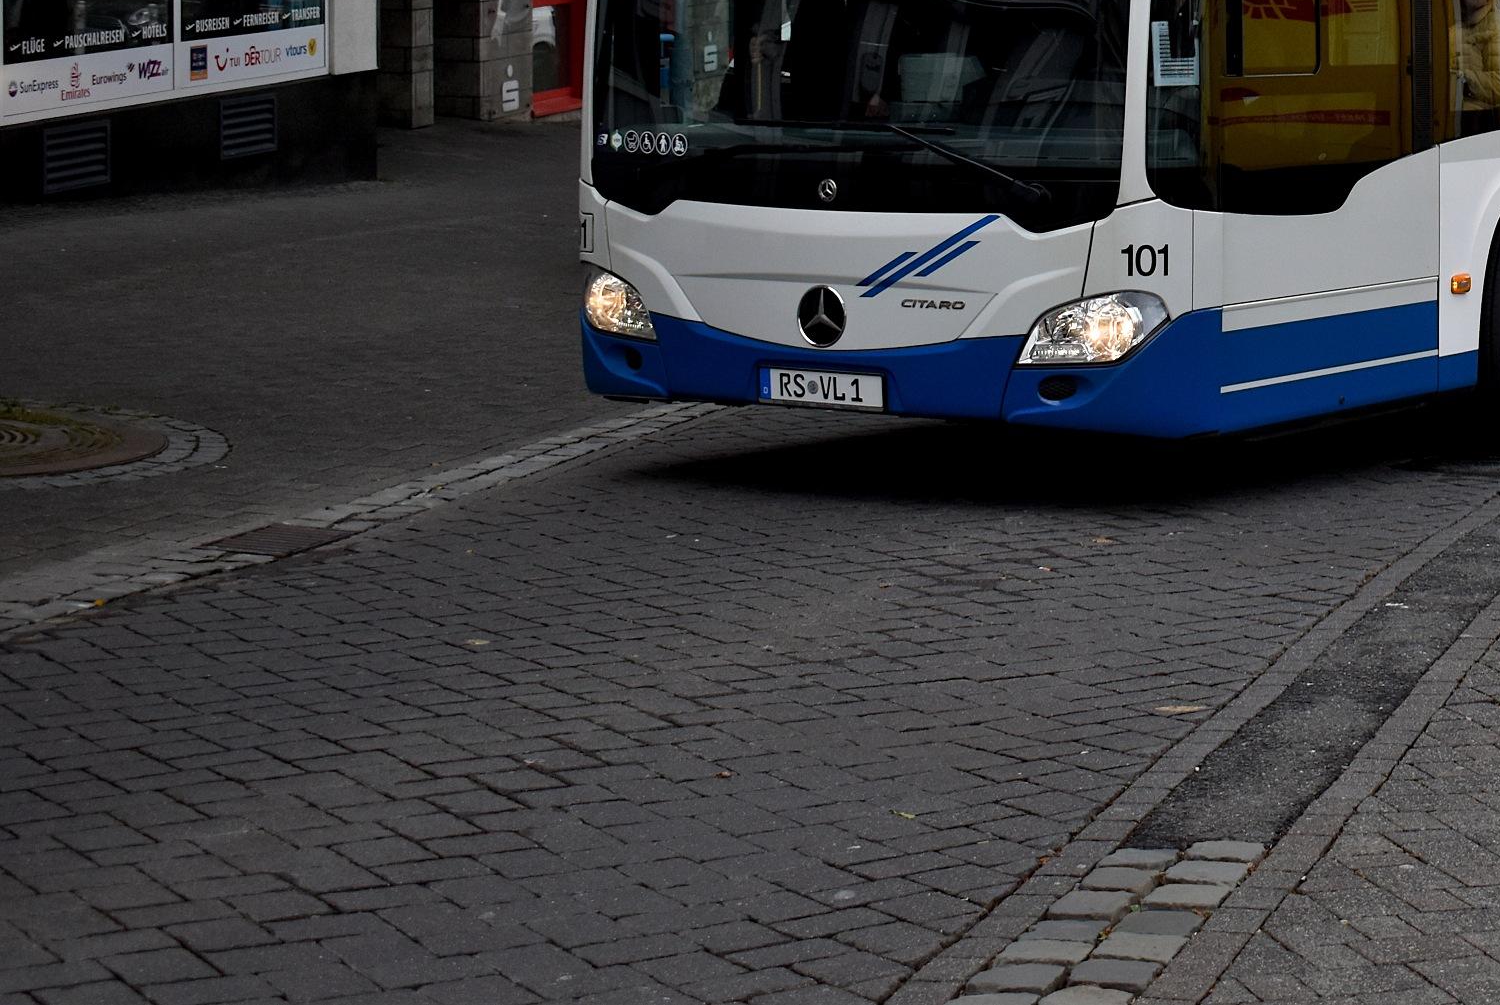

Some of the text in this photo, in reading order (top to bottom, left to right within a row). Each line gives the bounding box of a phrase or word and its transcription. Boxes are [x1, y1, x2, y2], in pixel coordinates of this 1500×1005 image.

[243, 11, 280, 27] FERNREISEN
[291, 6, 321, 21] TRANSFER
[142, 23, 167, 40] HOTELS
[195, 16, 230, 33] BUSREISEN
[22, 37, 46, 55] FLÜGE
[64, 28, 125, 50] PAUSCHALREISEN
[244, 46, 282, 67] DERTOUR
[285, 44, 308, 57] vtours
[230, 57, 241, 67] TUI
[91, 71, 128, 86] Eurowings
[19, 79, 59, 95] SunExpress
[61, 88, 91, 102] Emirates
[1120, 244, 1169, 277] 101
[901, 298, 966, 311] CITARO
[779, 372, 806, 398] RS
